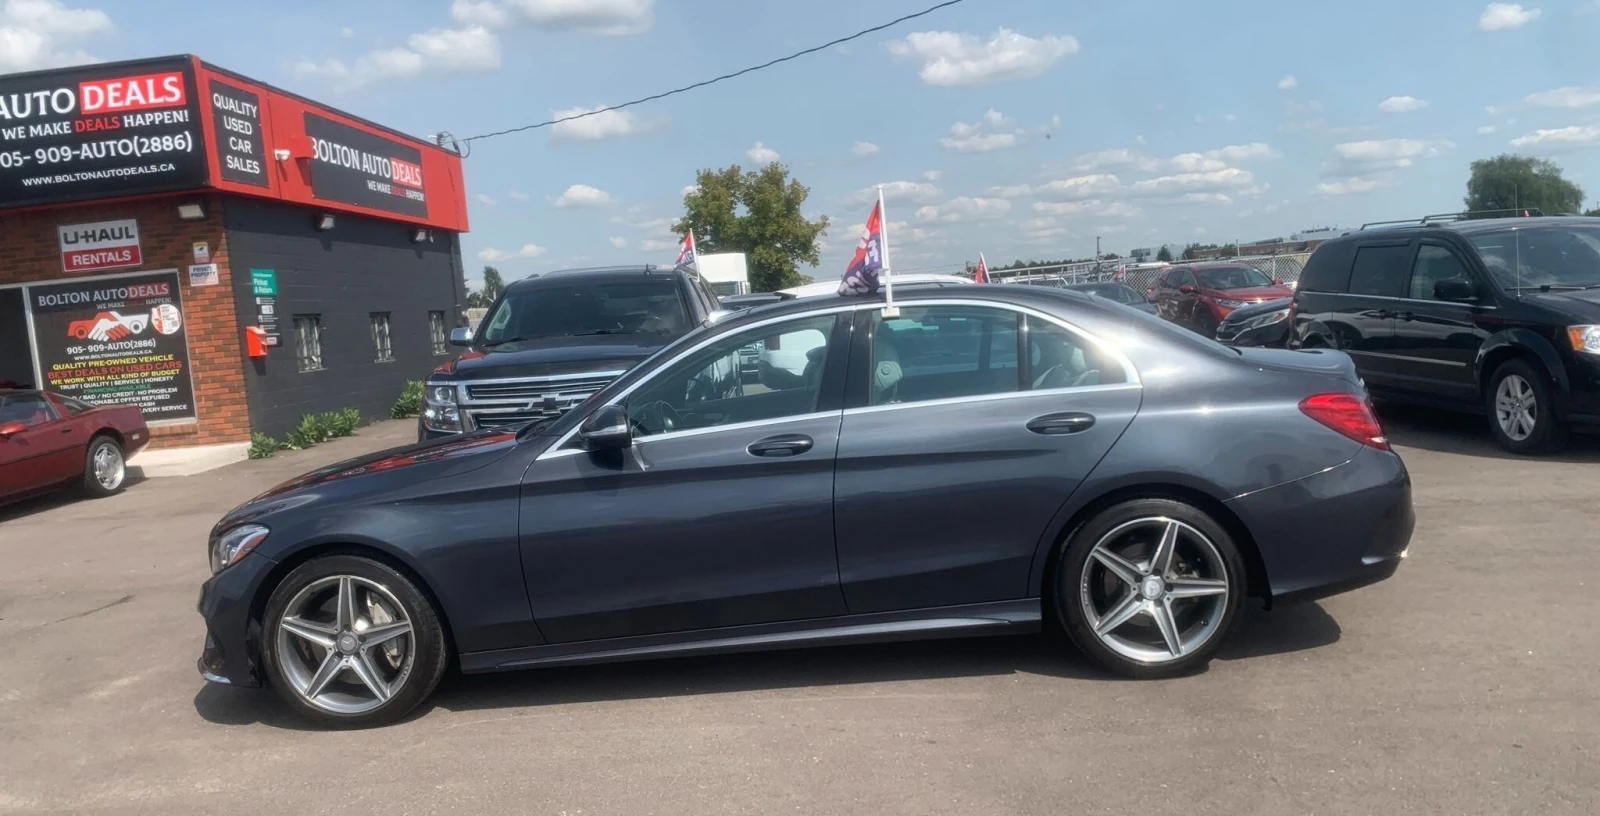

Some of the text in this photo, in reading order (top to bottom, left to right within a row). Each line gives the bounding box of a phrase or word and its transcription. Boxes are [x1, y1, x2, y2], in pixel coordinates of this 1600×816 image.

[82, 76, 181, 110] DEALS
[213, 92, 258, 118] QUALITY
[1, 110, 189, 140] WE MAKE DEALS HAPPEN!
[223, 115, 252, 135] USED
[35, 131, 193, 165] 909-AUTO(2886)
[229, 136, 252, 154] CAR
[226, 154, 260, 174] SALES
[362, 152, 392, 178] AUTO
[391, 160, 422, 186] DEALS
[22, 163, 176, 186] WWW.BOLTONAUTODEALS.CA
[367, 180, 377, 191] WE
[377, 182, 392, 194] MAKE
[63, 226, 135, 245] U-HAUL
[72, 250, 131, 266] RENTALS
[38, 283, 169, 307] BOLTON AUTO DEALS
[107, 301, 125, 309] MAKE
[67, 337, 156, 355] 905- 909-AUTO(2886)
[47, 360, 182, 379] BEST DEALS ON USED CARS
[53, 353, 174, 371] QUALITY PRE-OWNED VEHICLE
[63, 377, 86, 385] WORK
[86, 375, 106, 383] WITH
[151, 368, 180, 377] BUDGET
[83, 381, 110, 389] QUALITY
[114, 378, 140, 386] SERVICE
[145, 375, 174, 383] HONESTY
[141, 394, 170, 402] REFUSED
[148, 387, 178, 395] PROBLEM
[161, 404, 188, 412] SERVICE
